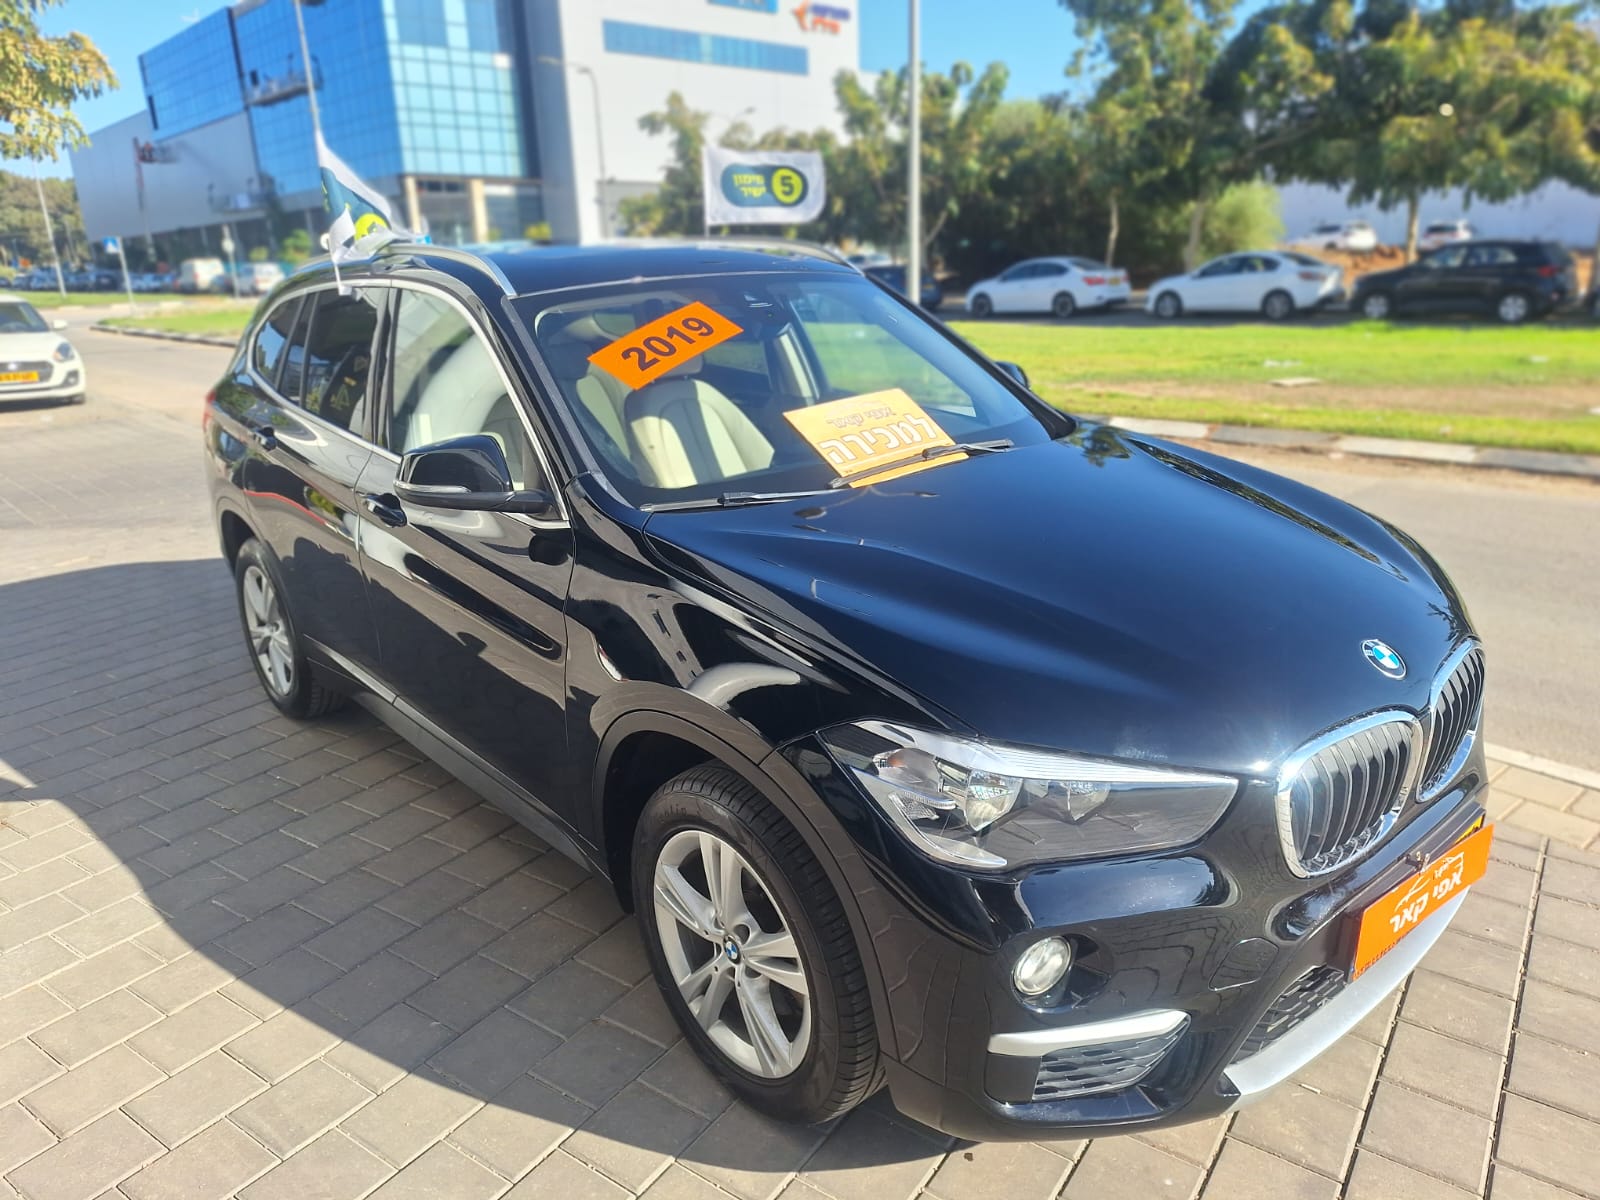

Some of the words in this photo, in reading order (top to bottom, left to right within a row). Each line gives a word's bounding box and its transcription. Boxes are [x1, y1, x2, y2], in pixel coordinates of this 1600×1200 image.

[780, 175, 796, 196] 5
[621, 317, 714, 372] 2019
[818, 413, 937, 465] למכירה
[1432, 868, 1463, 900] אפי
[1389, 892, 1430, 934] קאר
